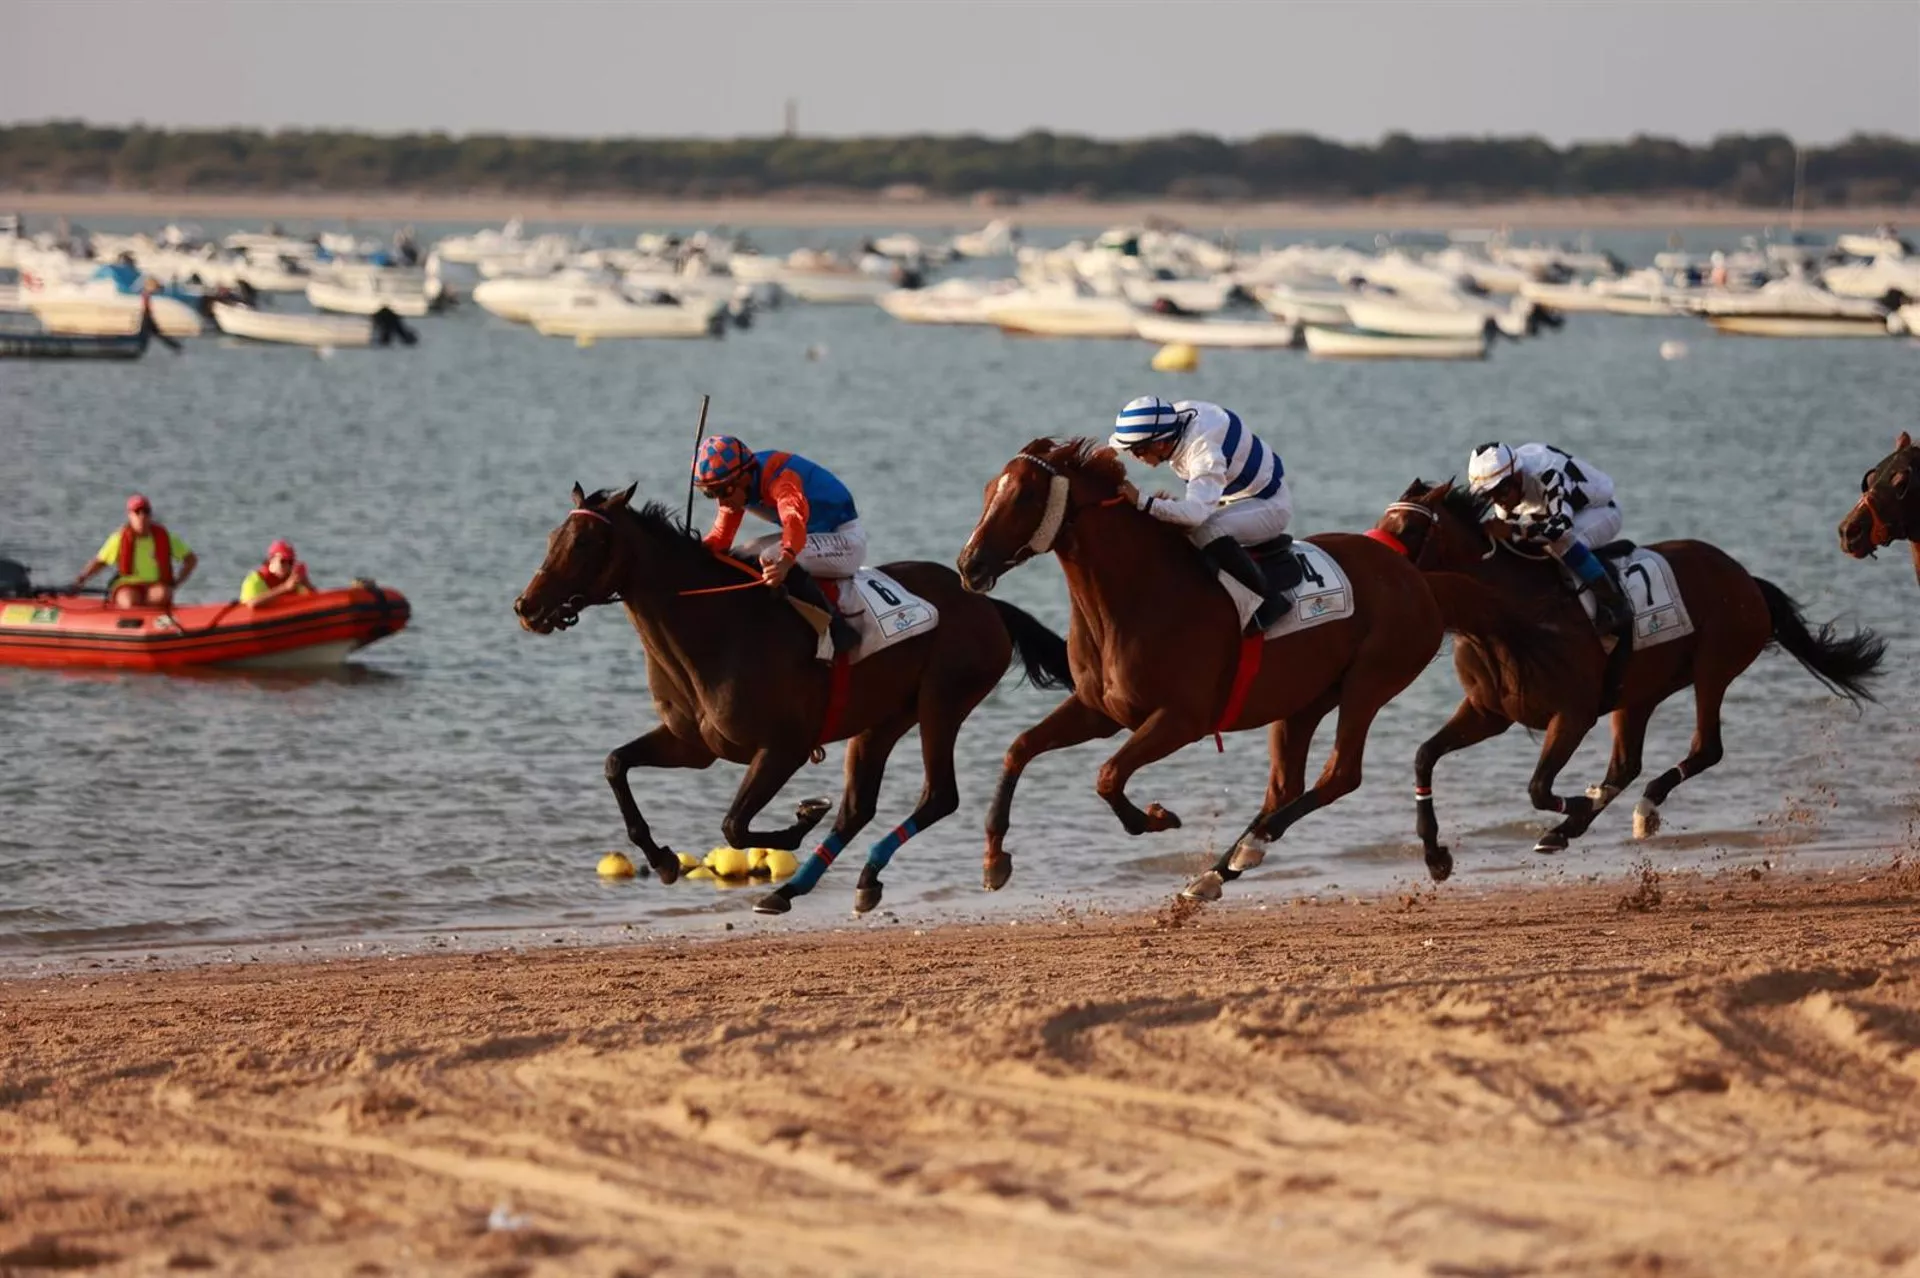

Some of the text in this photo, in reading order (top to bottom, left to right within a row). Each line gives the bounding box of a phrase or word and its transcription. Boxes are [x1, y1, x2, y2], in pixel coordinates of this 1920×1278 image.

[1296, 553, 1325, 588] 4
[1624, 563, 1654, 607] 7
[867, 579, 901, 606] 6
